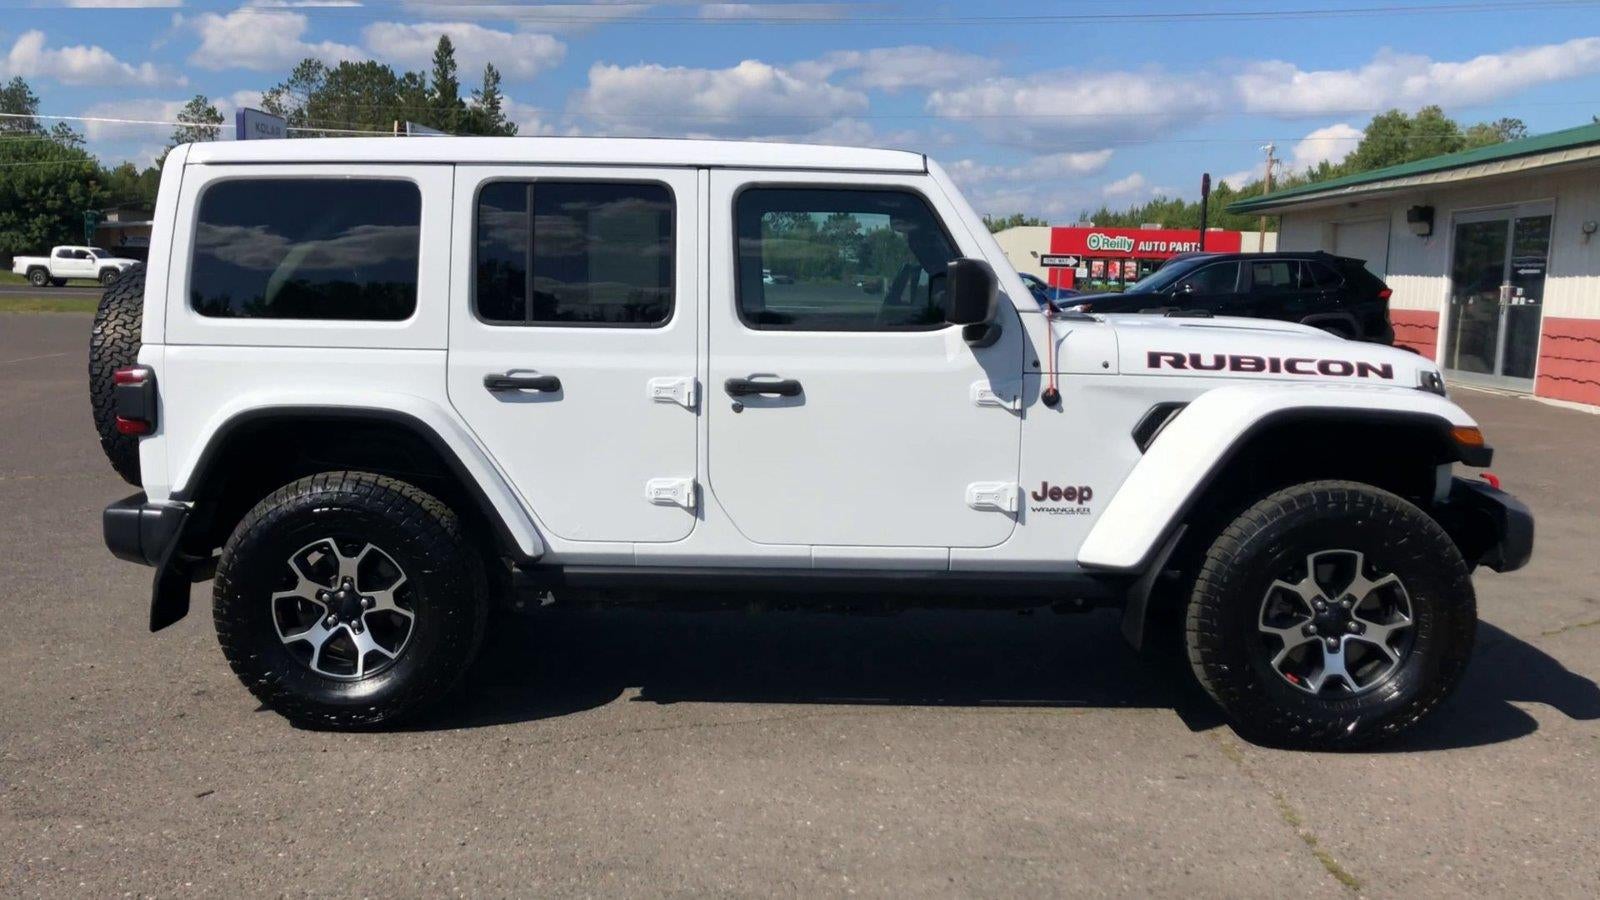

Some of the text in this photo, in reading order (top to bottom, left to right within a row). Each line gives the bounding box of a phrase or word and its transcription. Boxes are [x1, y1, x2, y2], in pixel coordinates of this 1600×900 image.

[1087, 233, 1135, 252] O'Reilly
[1138, 241, 1167, 251] AUTO
[1147, 351, 1394, 379] RUBICON
[1031, 481, 1093, 505] Jeep
